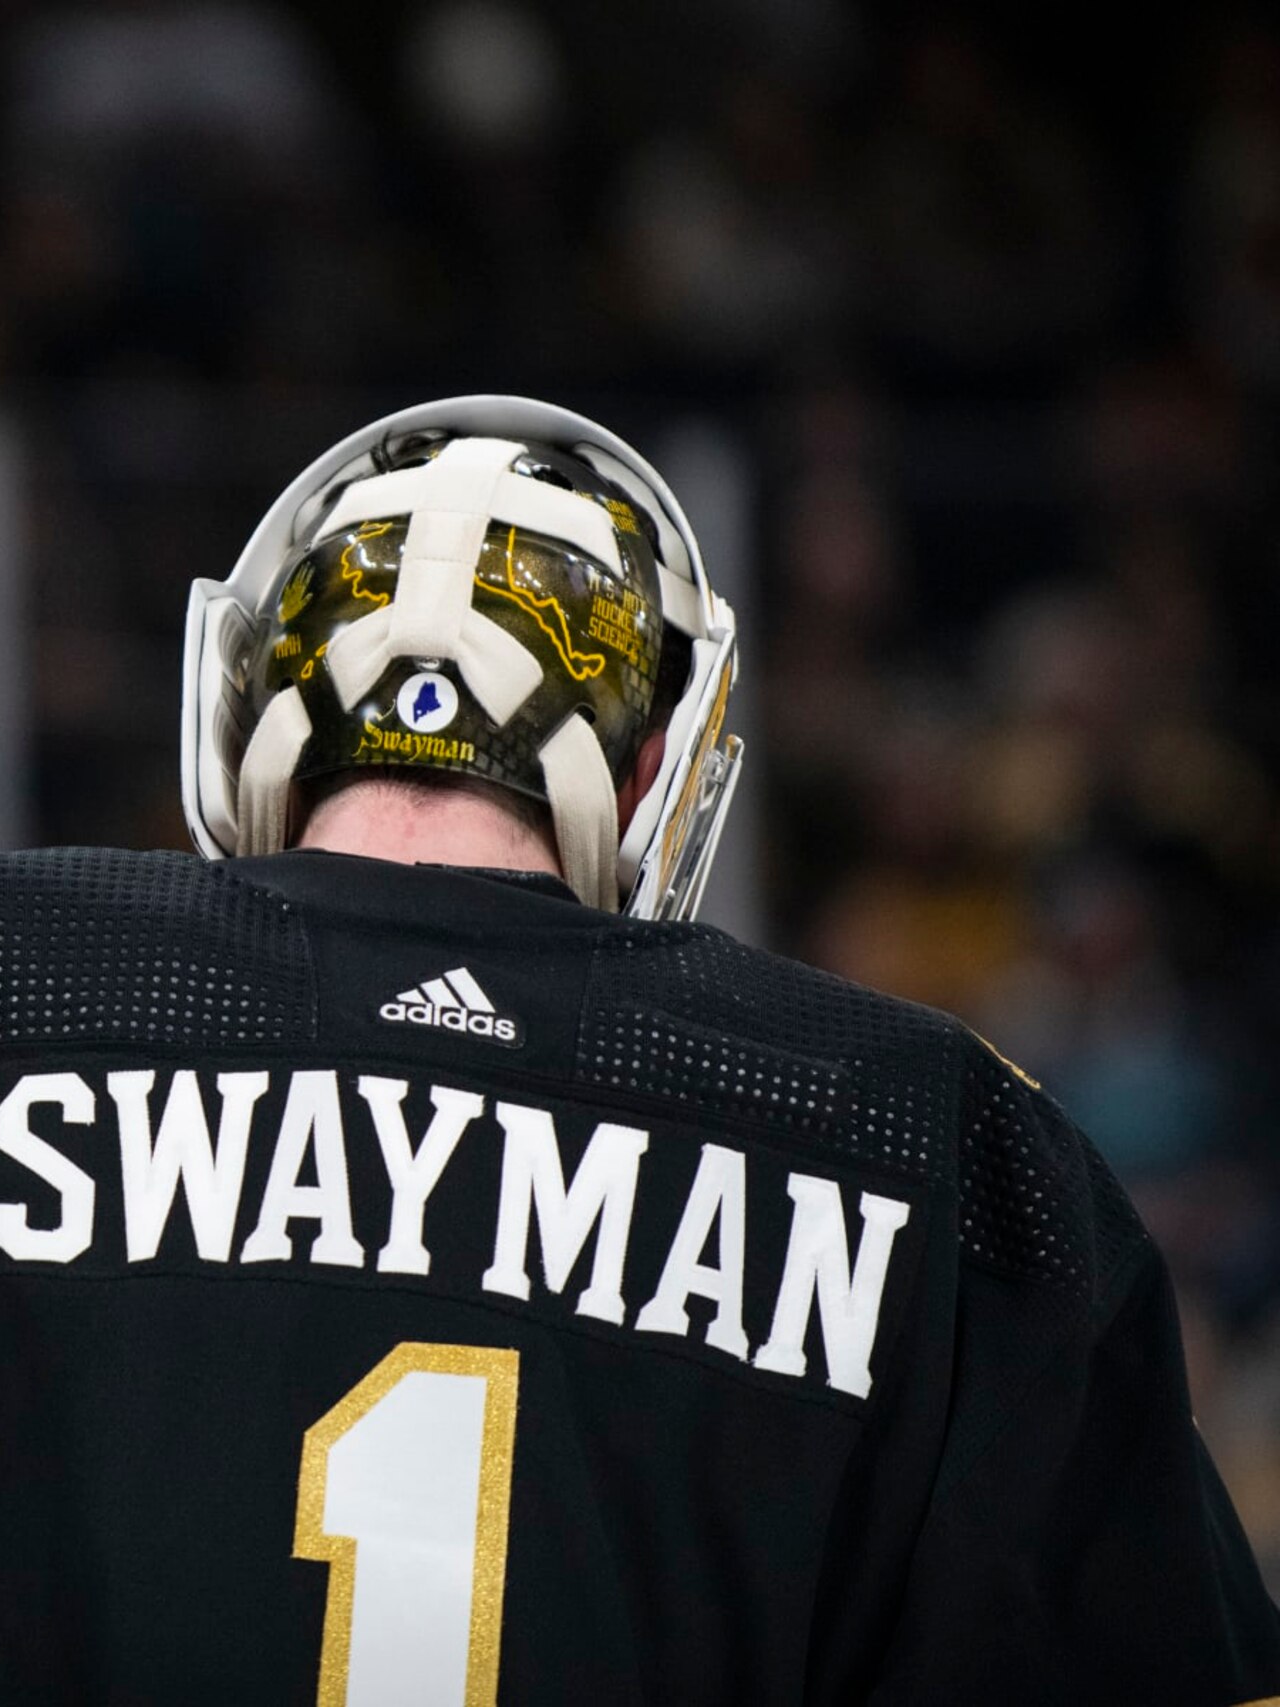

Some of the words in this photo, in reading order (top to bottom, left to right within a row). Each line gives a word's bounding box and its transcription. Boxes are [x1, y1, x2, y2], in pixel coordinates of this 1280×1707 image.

[352, 699, 474, 762] Swayman
[379, 1002, 516, 1041] adidas
[293, 1341, 520, 1707] 1
